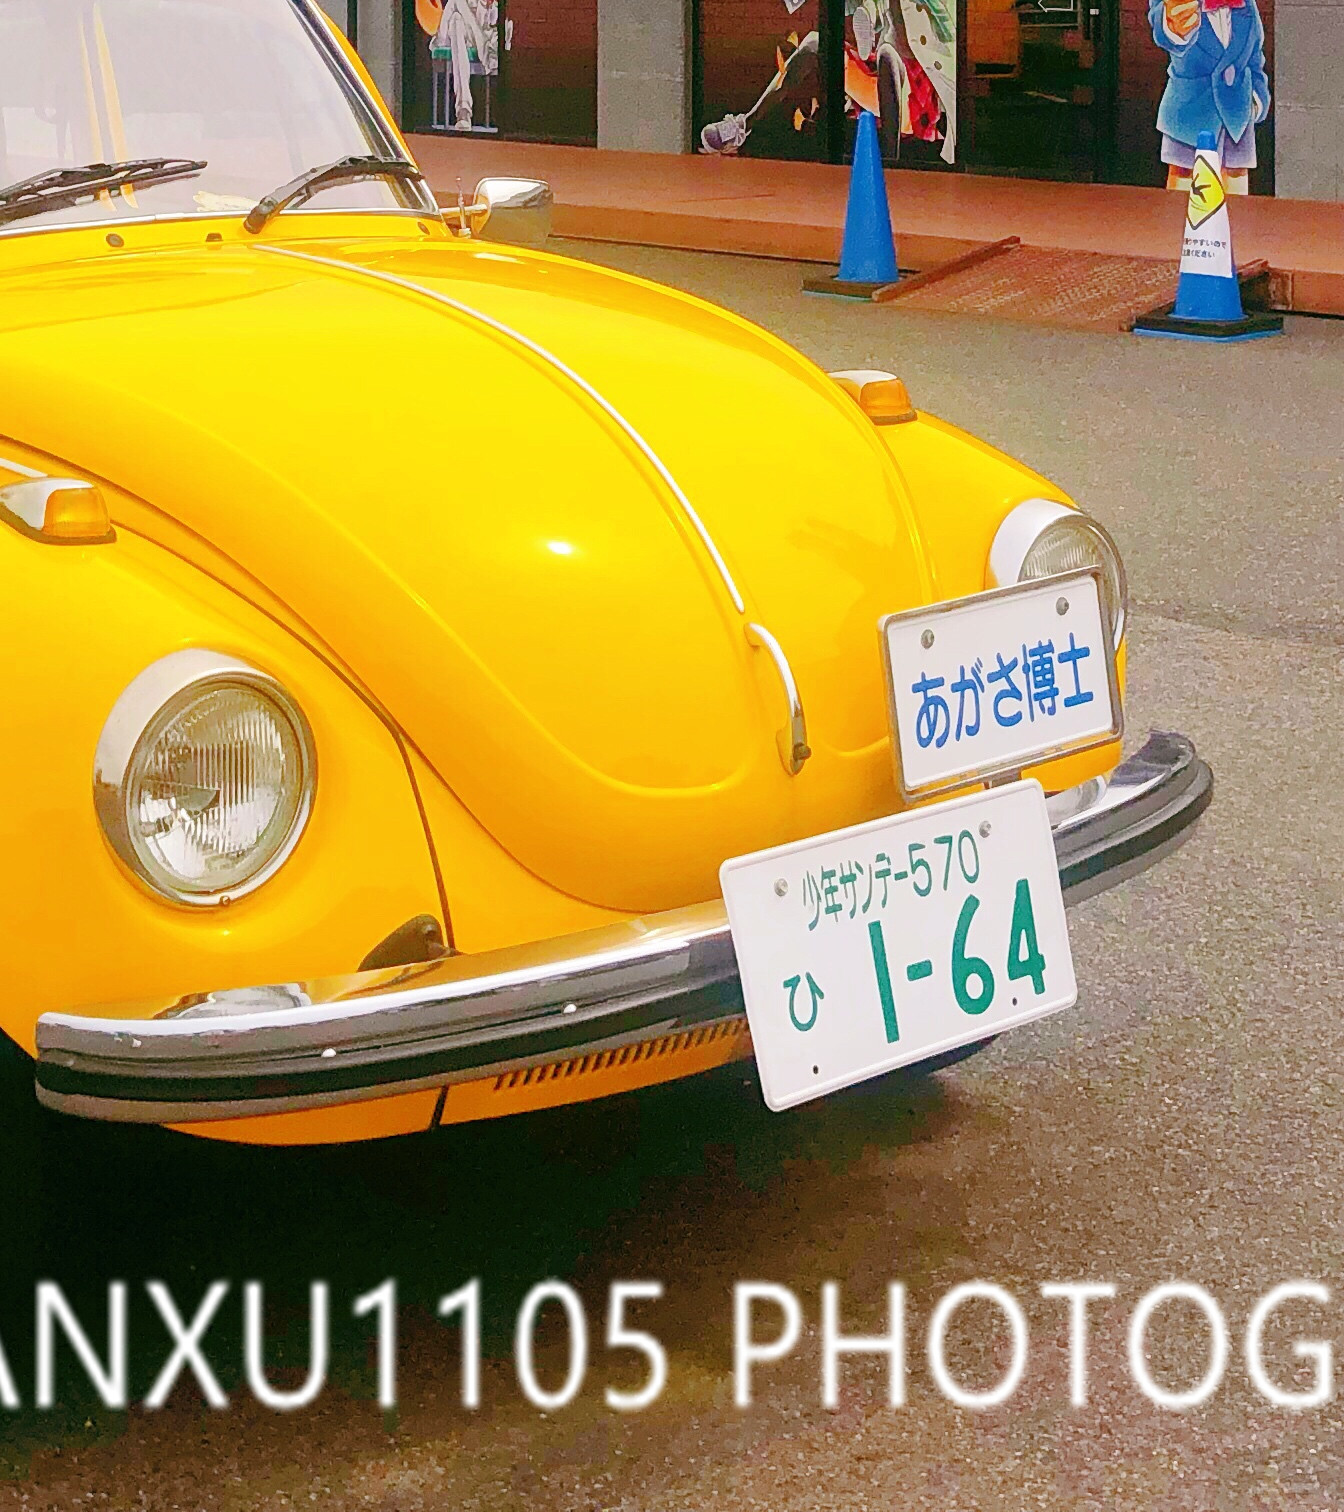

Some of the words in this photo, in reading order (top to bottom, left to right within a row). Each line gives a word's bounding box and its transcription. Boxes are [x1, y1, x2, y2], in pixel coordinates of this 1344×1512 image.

[910, 631, 1094, 749] あがさ博士
[782, 971, 825, 1032] ひ
[867, 879, 1047, 1045] 1-64
